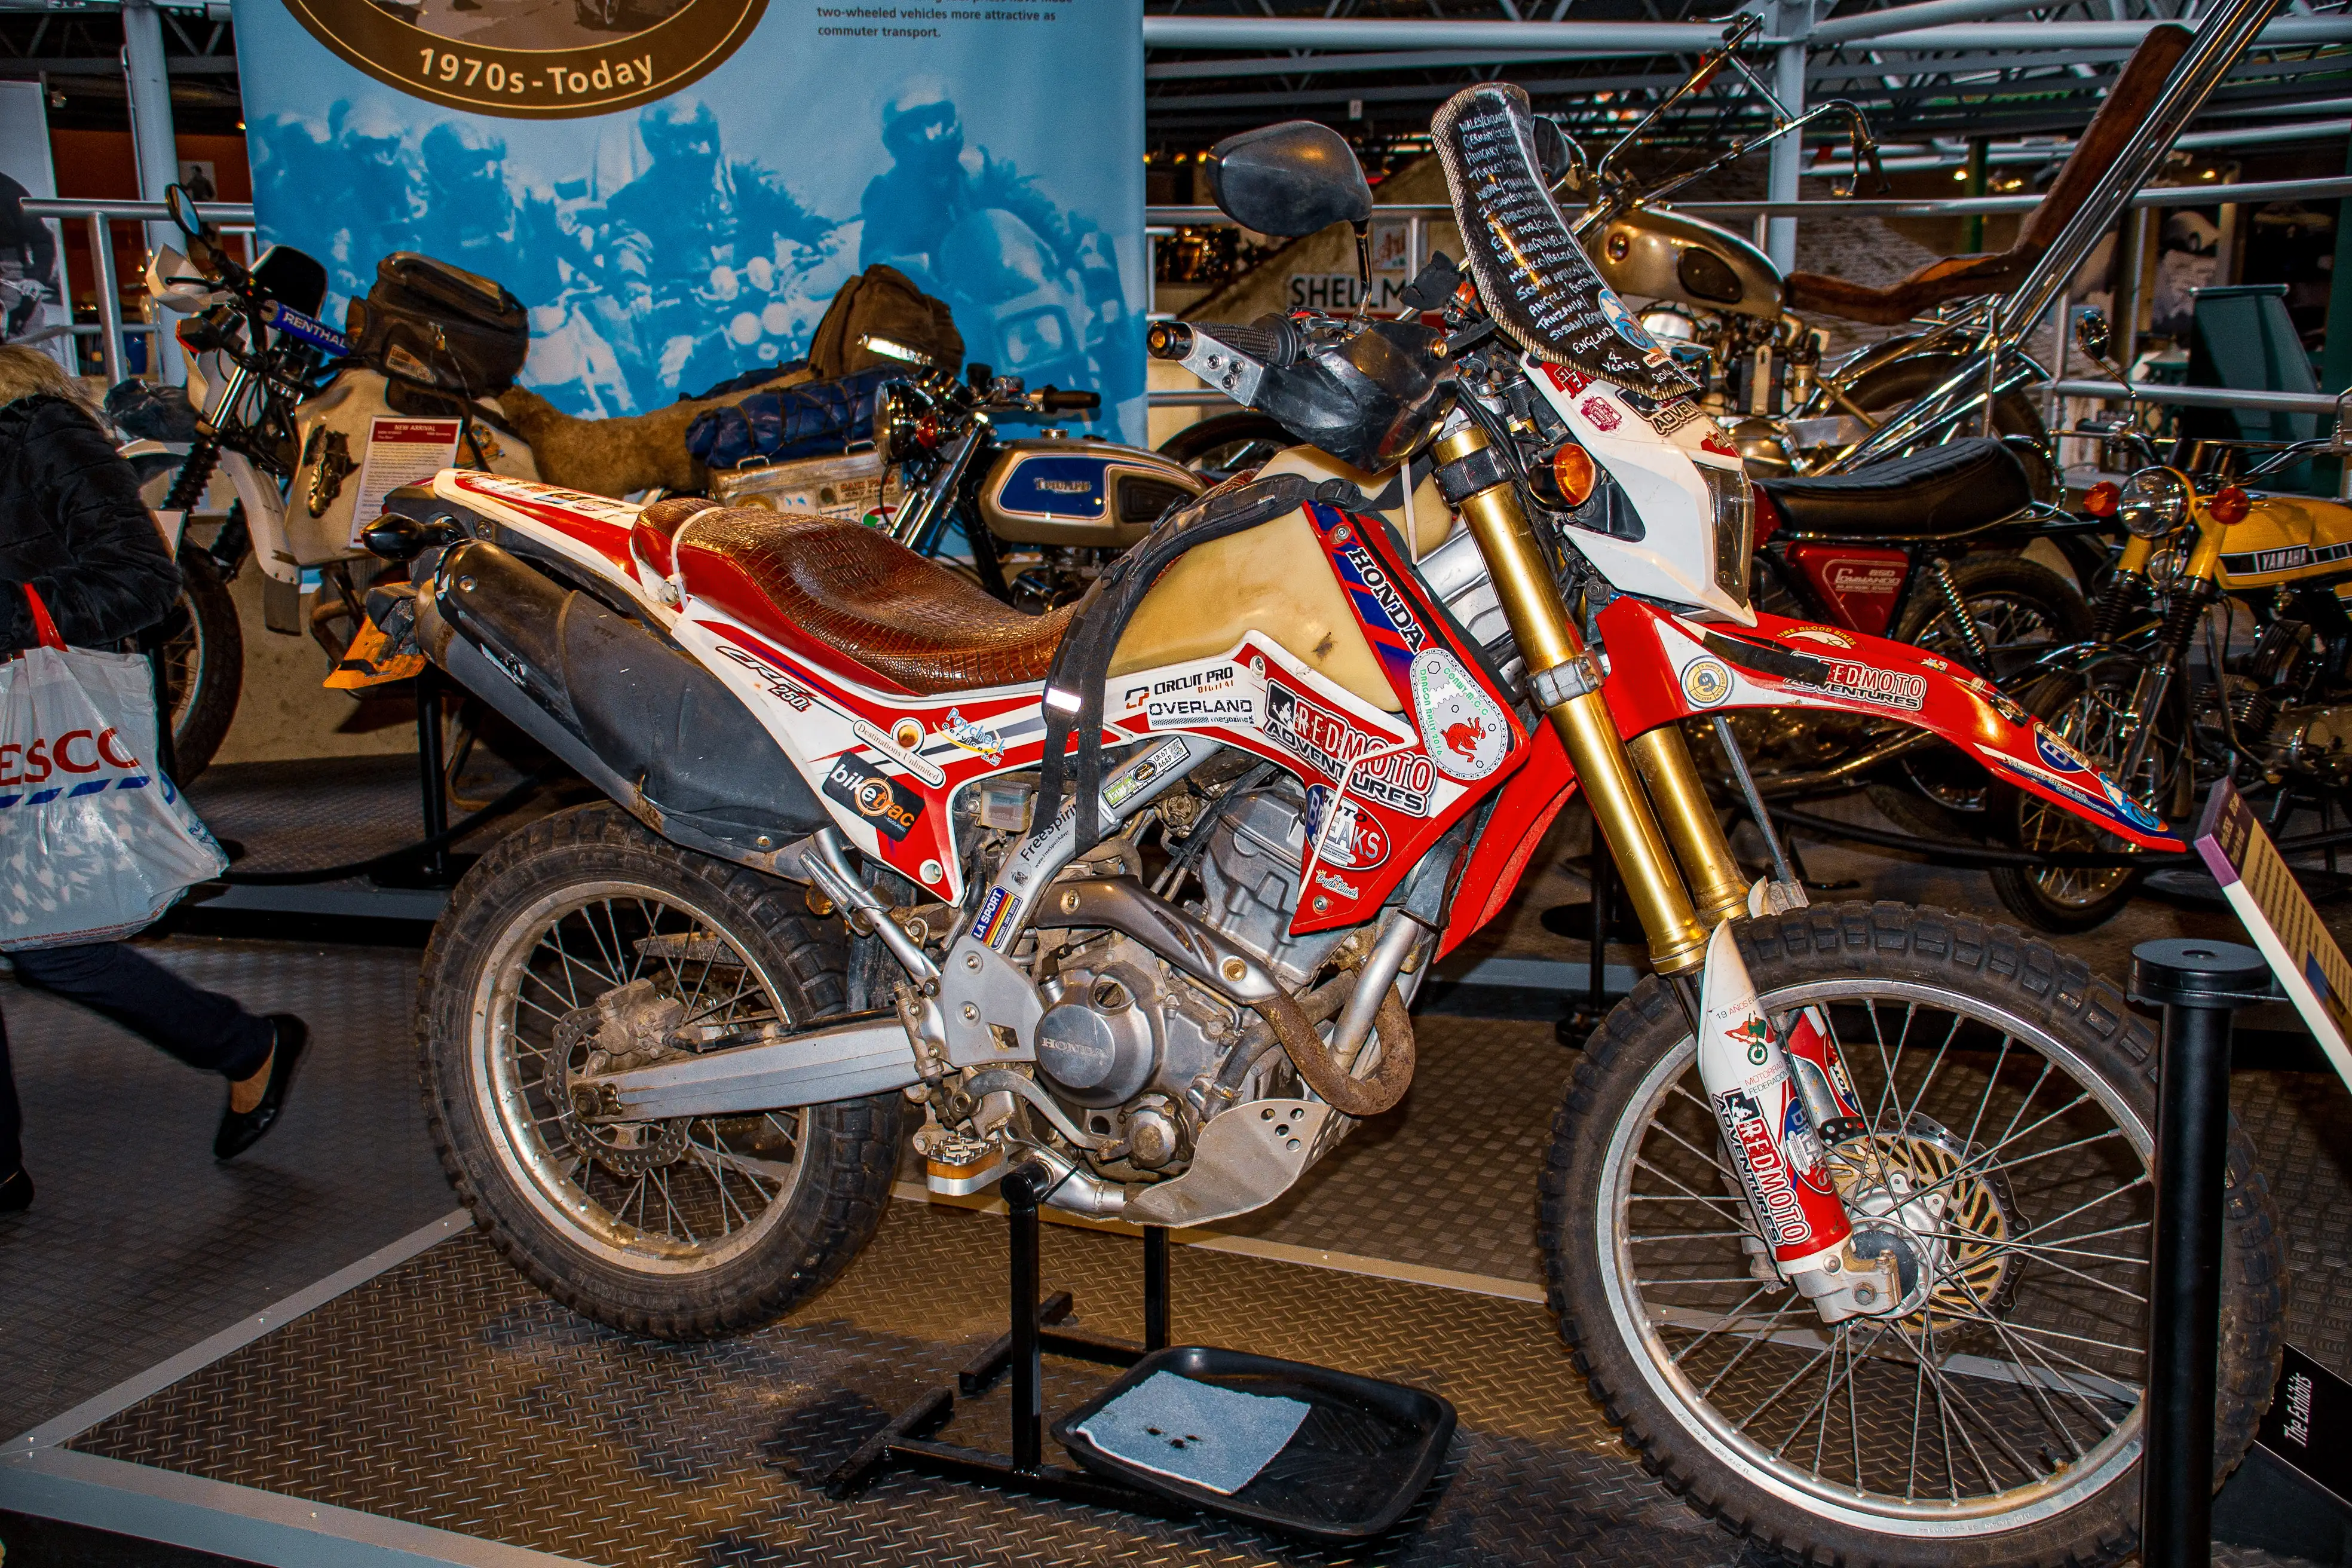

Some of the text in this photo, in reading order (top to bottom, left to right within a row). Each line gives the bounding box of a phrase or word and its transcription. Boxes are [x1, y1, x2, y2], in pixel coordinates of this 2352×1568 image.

[817, 7, 896, 19] two-wheeled
[900, 9, 947, 20] vehicles
[951, 11, 982, 20] more
[985, 11, 1040, 21] attractive
[817, 26, 942, 38] commuter transport.
[282, 310, 347, 348] RENTHAL
[1572, 327, 1615, 354] ENGLAND
[1601, 360, 1640, 373] YEARS
[410, 423, 436, 432] ARRIVAL
[2262, 548, 2307, 571] YAMAHA
[1346, 546, 1428, 656] HONDA
[1833, 630, 1857, 646] BIKES
[1154, 666, 1234, 695] CIRCUIT PRO
[1149, 699, 1252, 716] OVERLAND
[1210, 715, 1249, 724] magazine
[1419, 669, 1443, 756] DRAGON RALLY 2016
[942, 723, 990, 756] Services
[946, 708, 1006, 756] Paycheck
[857, 723, 941, 782] Destinations Unlimited
[1296, 704, 1432, 794] REDMOTO
[1265, 721, 1423, 811] ADVENTURES
[831, 764, 915, 828] biketrac
[973, 889, 1003, 939] LA SPORT
[1716, 1010, 1728, 1020] 19
[1728, 999, 1749, 1015] AÑOS
[1041, 1037, 1109, 1061] HONDA
[1744, 1061, 1784, 1087] MOTORRAD
[1712, 1092, 1781, 1247] ADVENTURES
[1739, 1120, 1811, 1244] REDMOTO
[2284, 1372, 2313, 1448] The Exhibits
